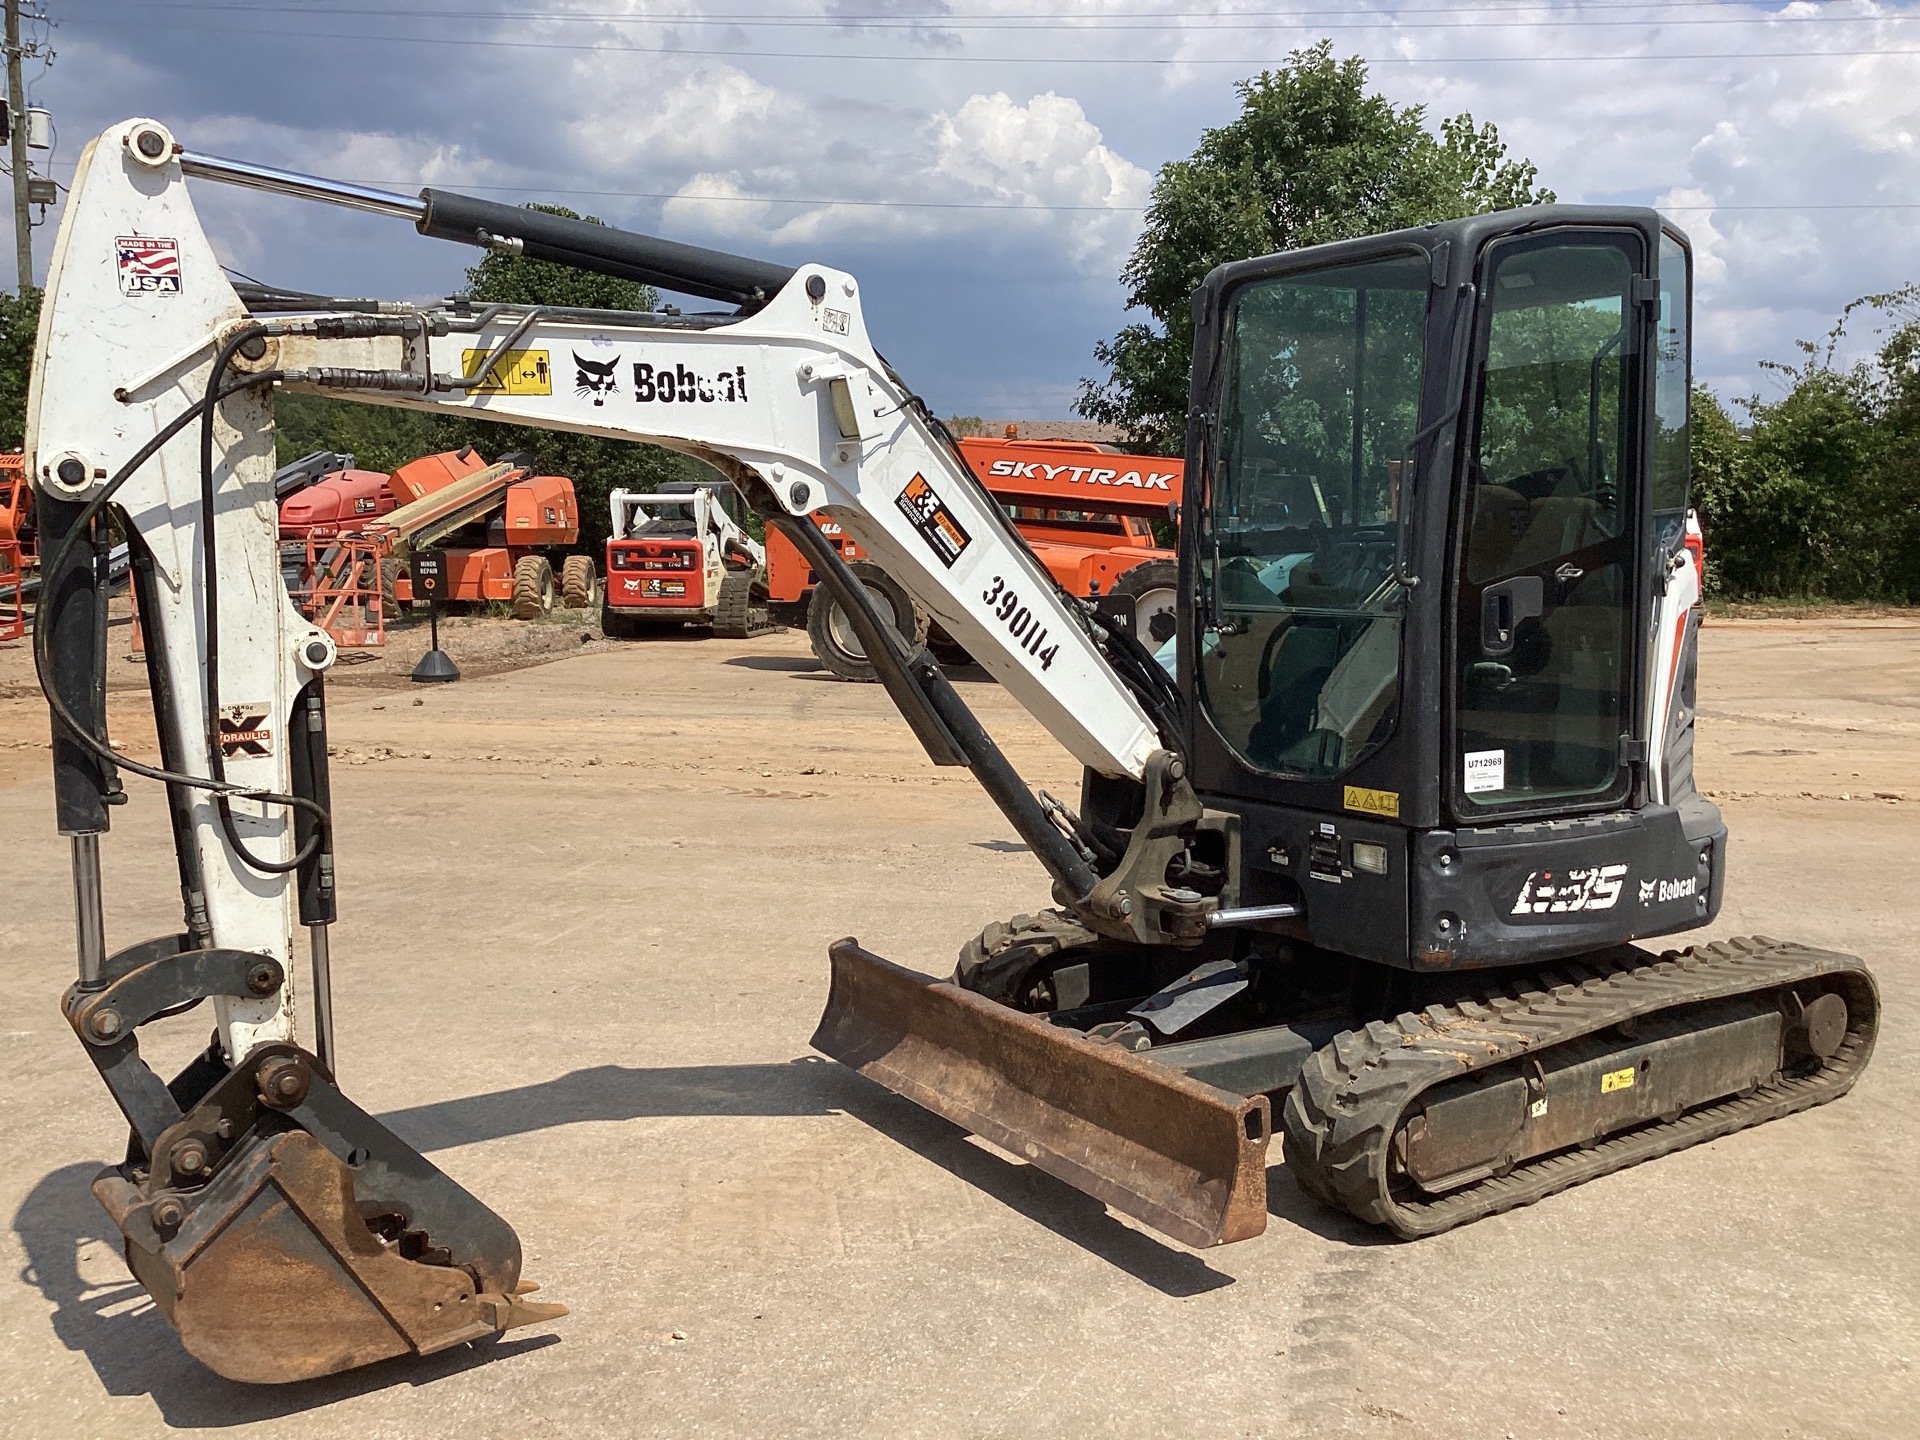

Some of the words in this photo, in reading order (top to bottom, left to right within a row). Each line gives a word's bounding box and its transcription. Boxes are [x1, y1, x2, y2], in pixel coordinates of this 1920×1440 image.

[120, 240, 145, 248] MADE
[124, 276, 177, 291] USA
[988, 459, 1179, 491] SKYTRAK
[900, 492, 926, 524] EQUIPMENT
[982, 575, 1060, 672] 390114
[220, 731, 268, 743] DRAULIC
[1468, 757, 1502, 769] U712969
[1658, 876, 1697, 902] Bobcat
